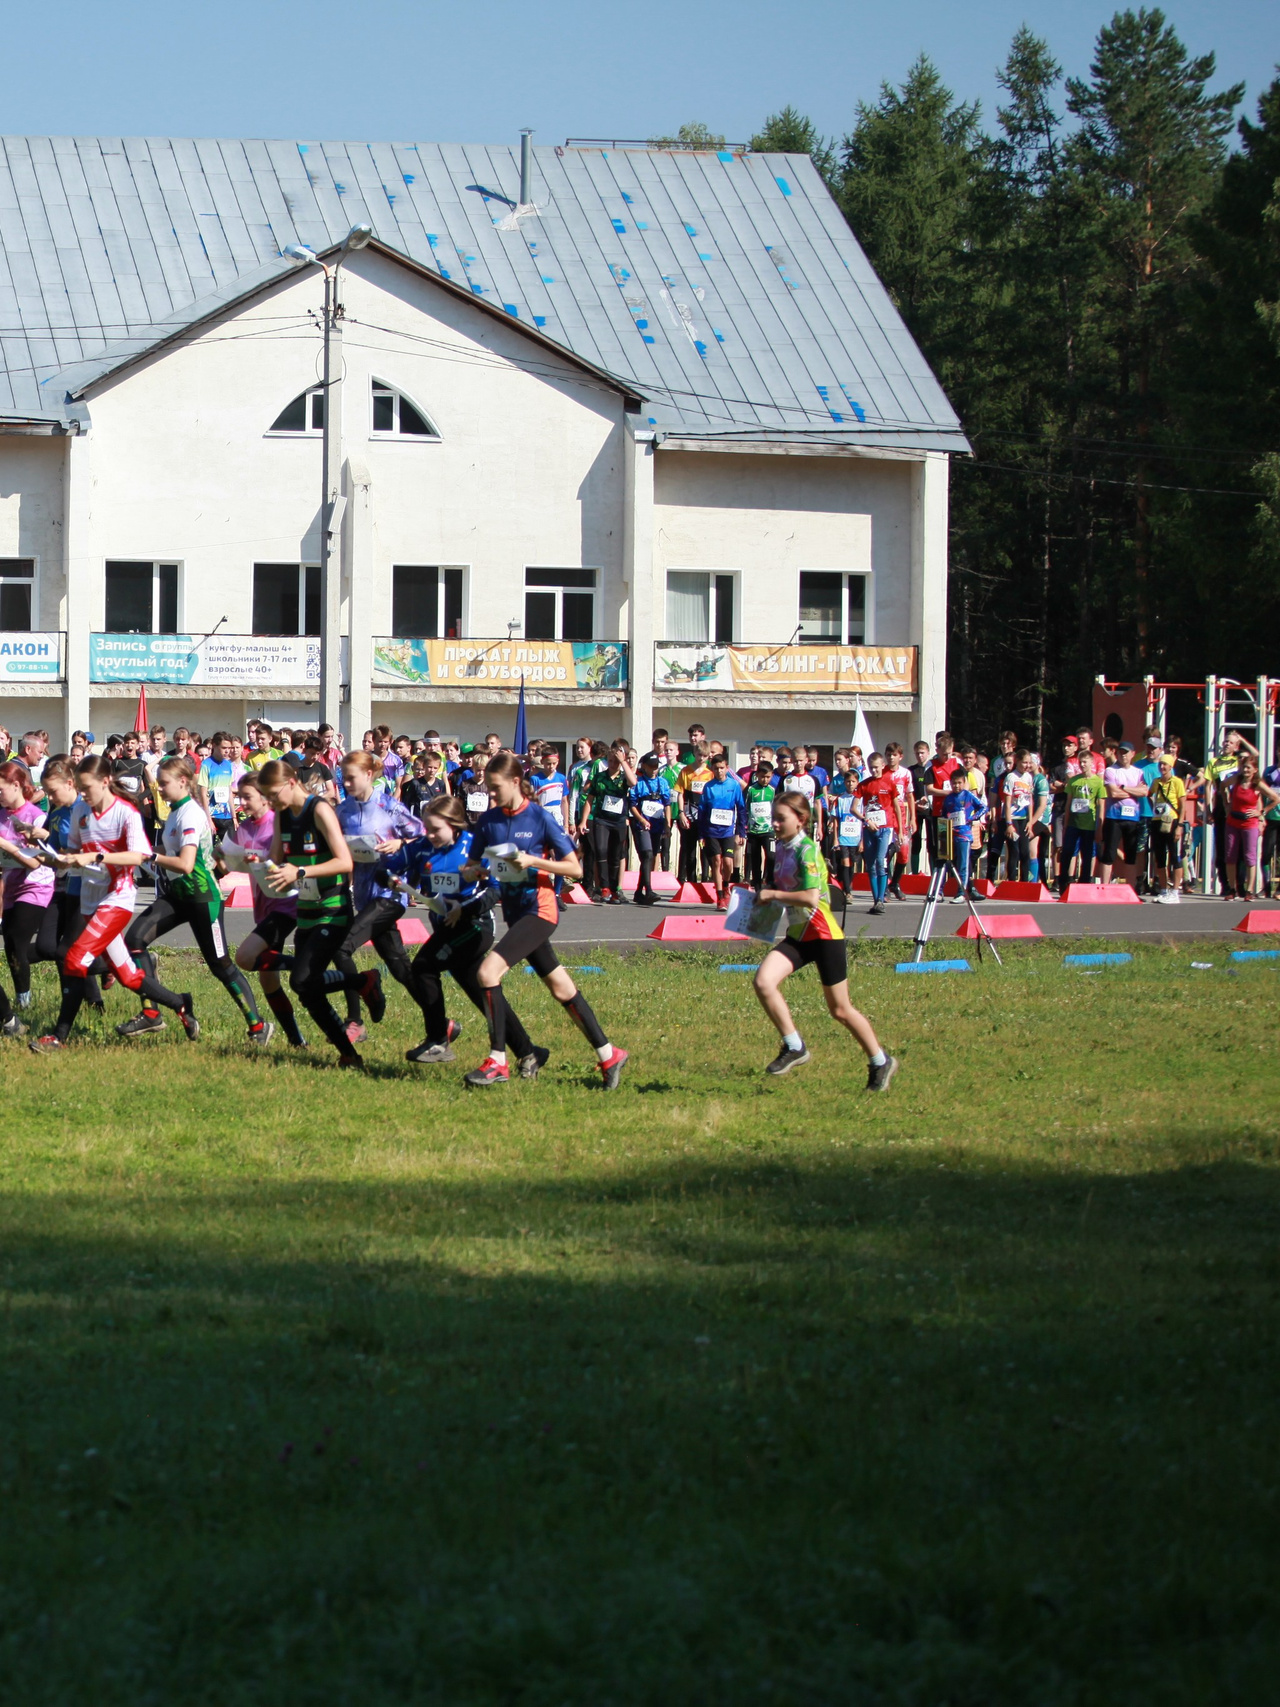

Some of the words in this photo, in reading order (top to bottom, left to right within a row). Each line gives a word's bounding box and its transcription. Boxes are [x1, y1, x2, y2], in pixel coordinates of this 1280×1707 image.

[96, 639, 147, 651] Запись
[209, 644, 280, 653] кунгфу-малыш
[262, 655, 280, 663] 7-17
[444, 647, 511, 662] ПРОКАТ
[515, 648, 560, 663] ЛЫЖ
[96, 655, 157, 669] круглый
[738, 655, 908, 674] ТЮБИНГ-ПРОКАТ
[208, 665, 253, 674] взрослые
[255, 665, 272, 673] 40+
[437, 664, 449, 678] И
[454, 665, 567, 682] СНОУБОРДОВ
